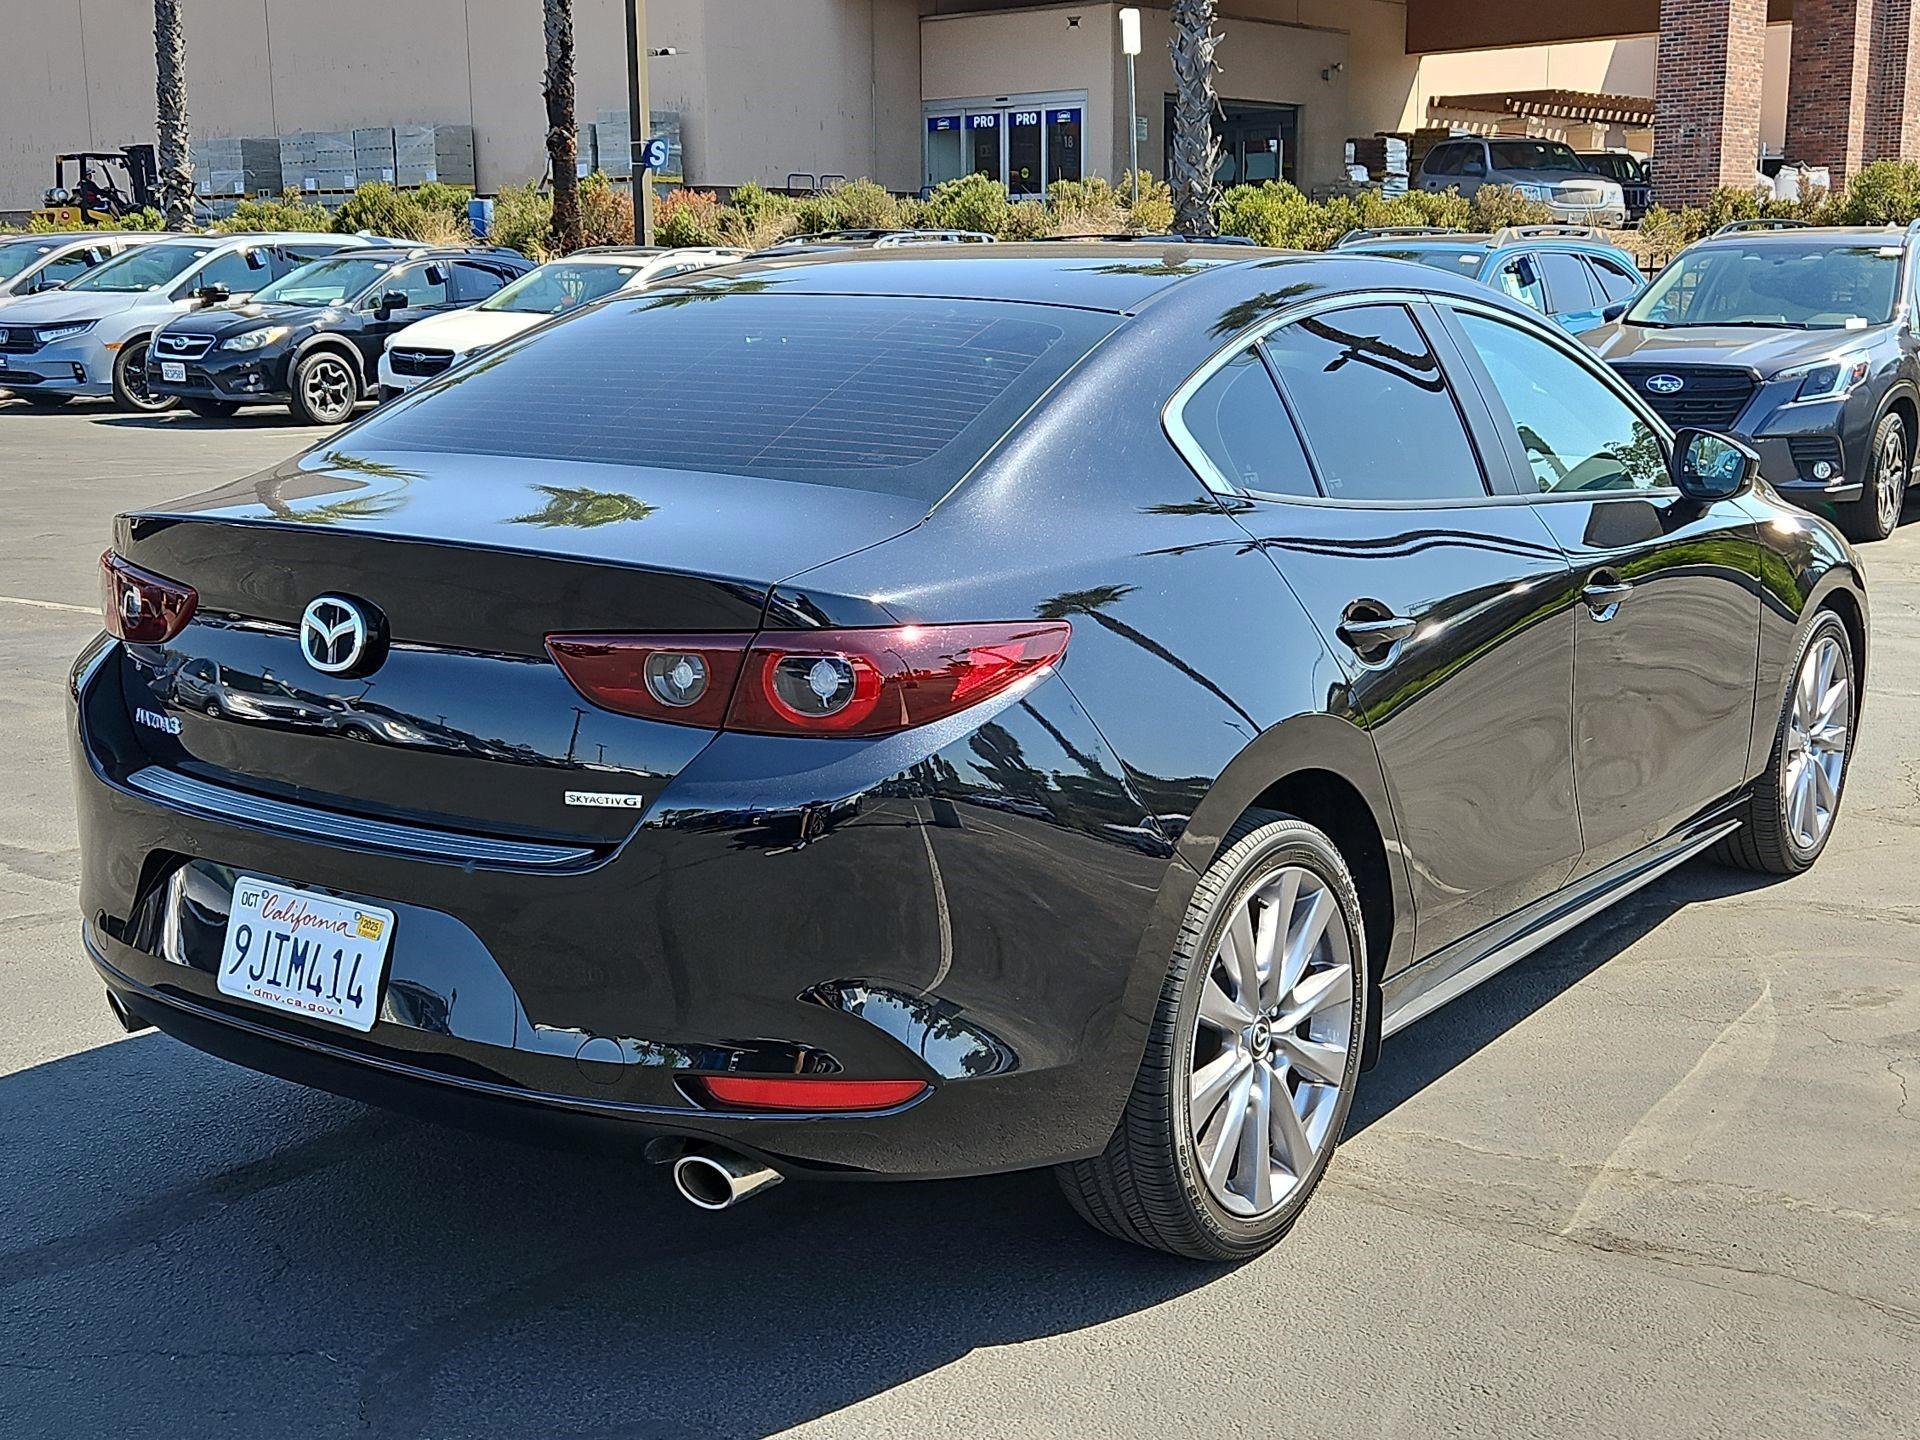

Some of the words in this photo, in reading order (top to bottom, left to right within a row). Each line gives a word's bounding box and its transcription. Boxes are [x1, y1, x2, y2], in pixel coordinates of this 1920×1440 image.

[973, 115, 995, 128] PRO
[1015, 112, 1037, 126] PRO
[1064, 136, 1074, 148] 18
[649, 141, 666, 166] S
[241, 891, 260, 908] OCT
[261, 893, 356, 938] California
[361, 918, 379, 932] 2025
[229, 924, 363, 1009] 9JIM414
[254, 988, 334, 1015] dmv.ca.gov
